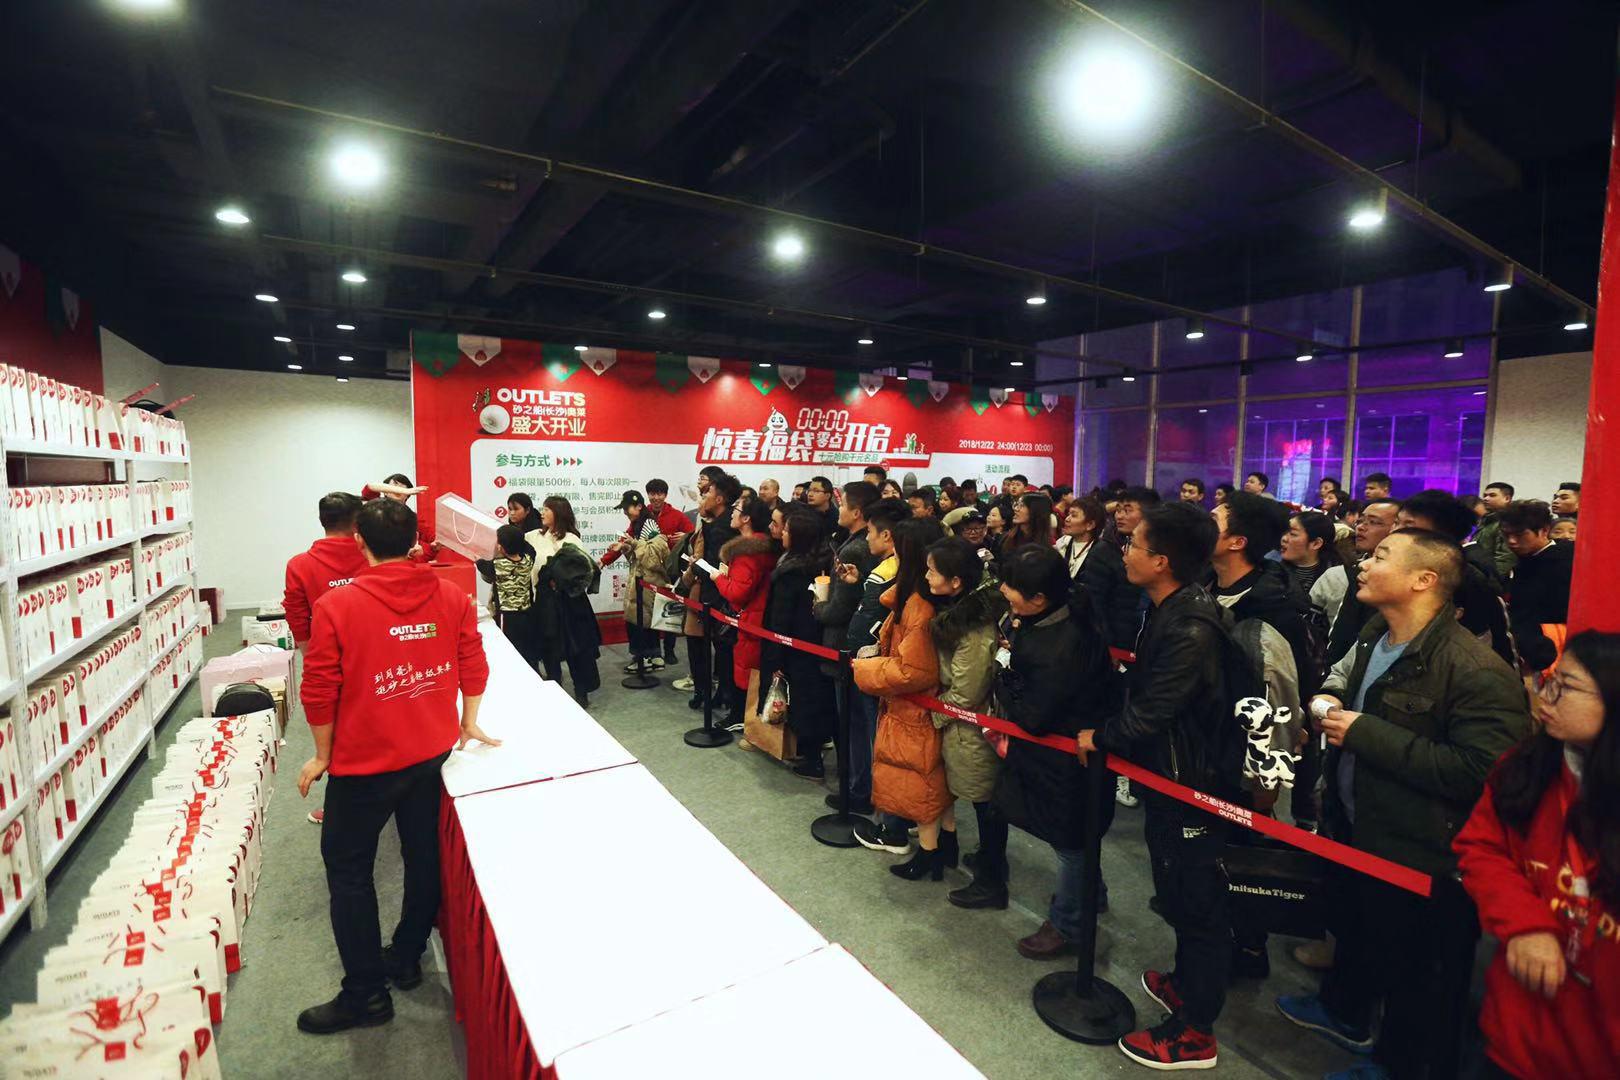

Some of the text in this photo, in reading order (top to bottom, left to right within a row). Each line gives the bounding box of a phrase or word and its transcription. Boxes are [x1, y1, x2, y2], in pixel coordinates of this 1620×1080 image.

[497, 387, 586, 407] OUTLETS
[512, 404, 586, 417] 砂之船(长沙)奥莱
[512, 415, 586, 437] 盛大开业
[796, 407, 850, 432] 00:00
[958, 439, 995, 450] 2018/12/22
[495, 453, 550, 468] 参与方式
[389, 623, 437, 636] OUTLETS
[1218, 809, 1253, 827] OUTLETS
